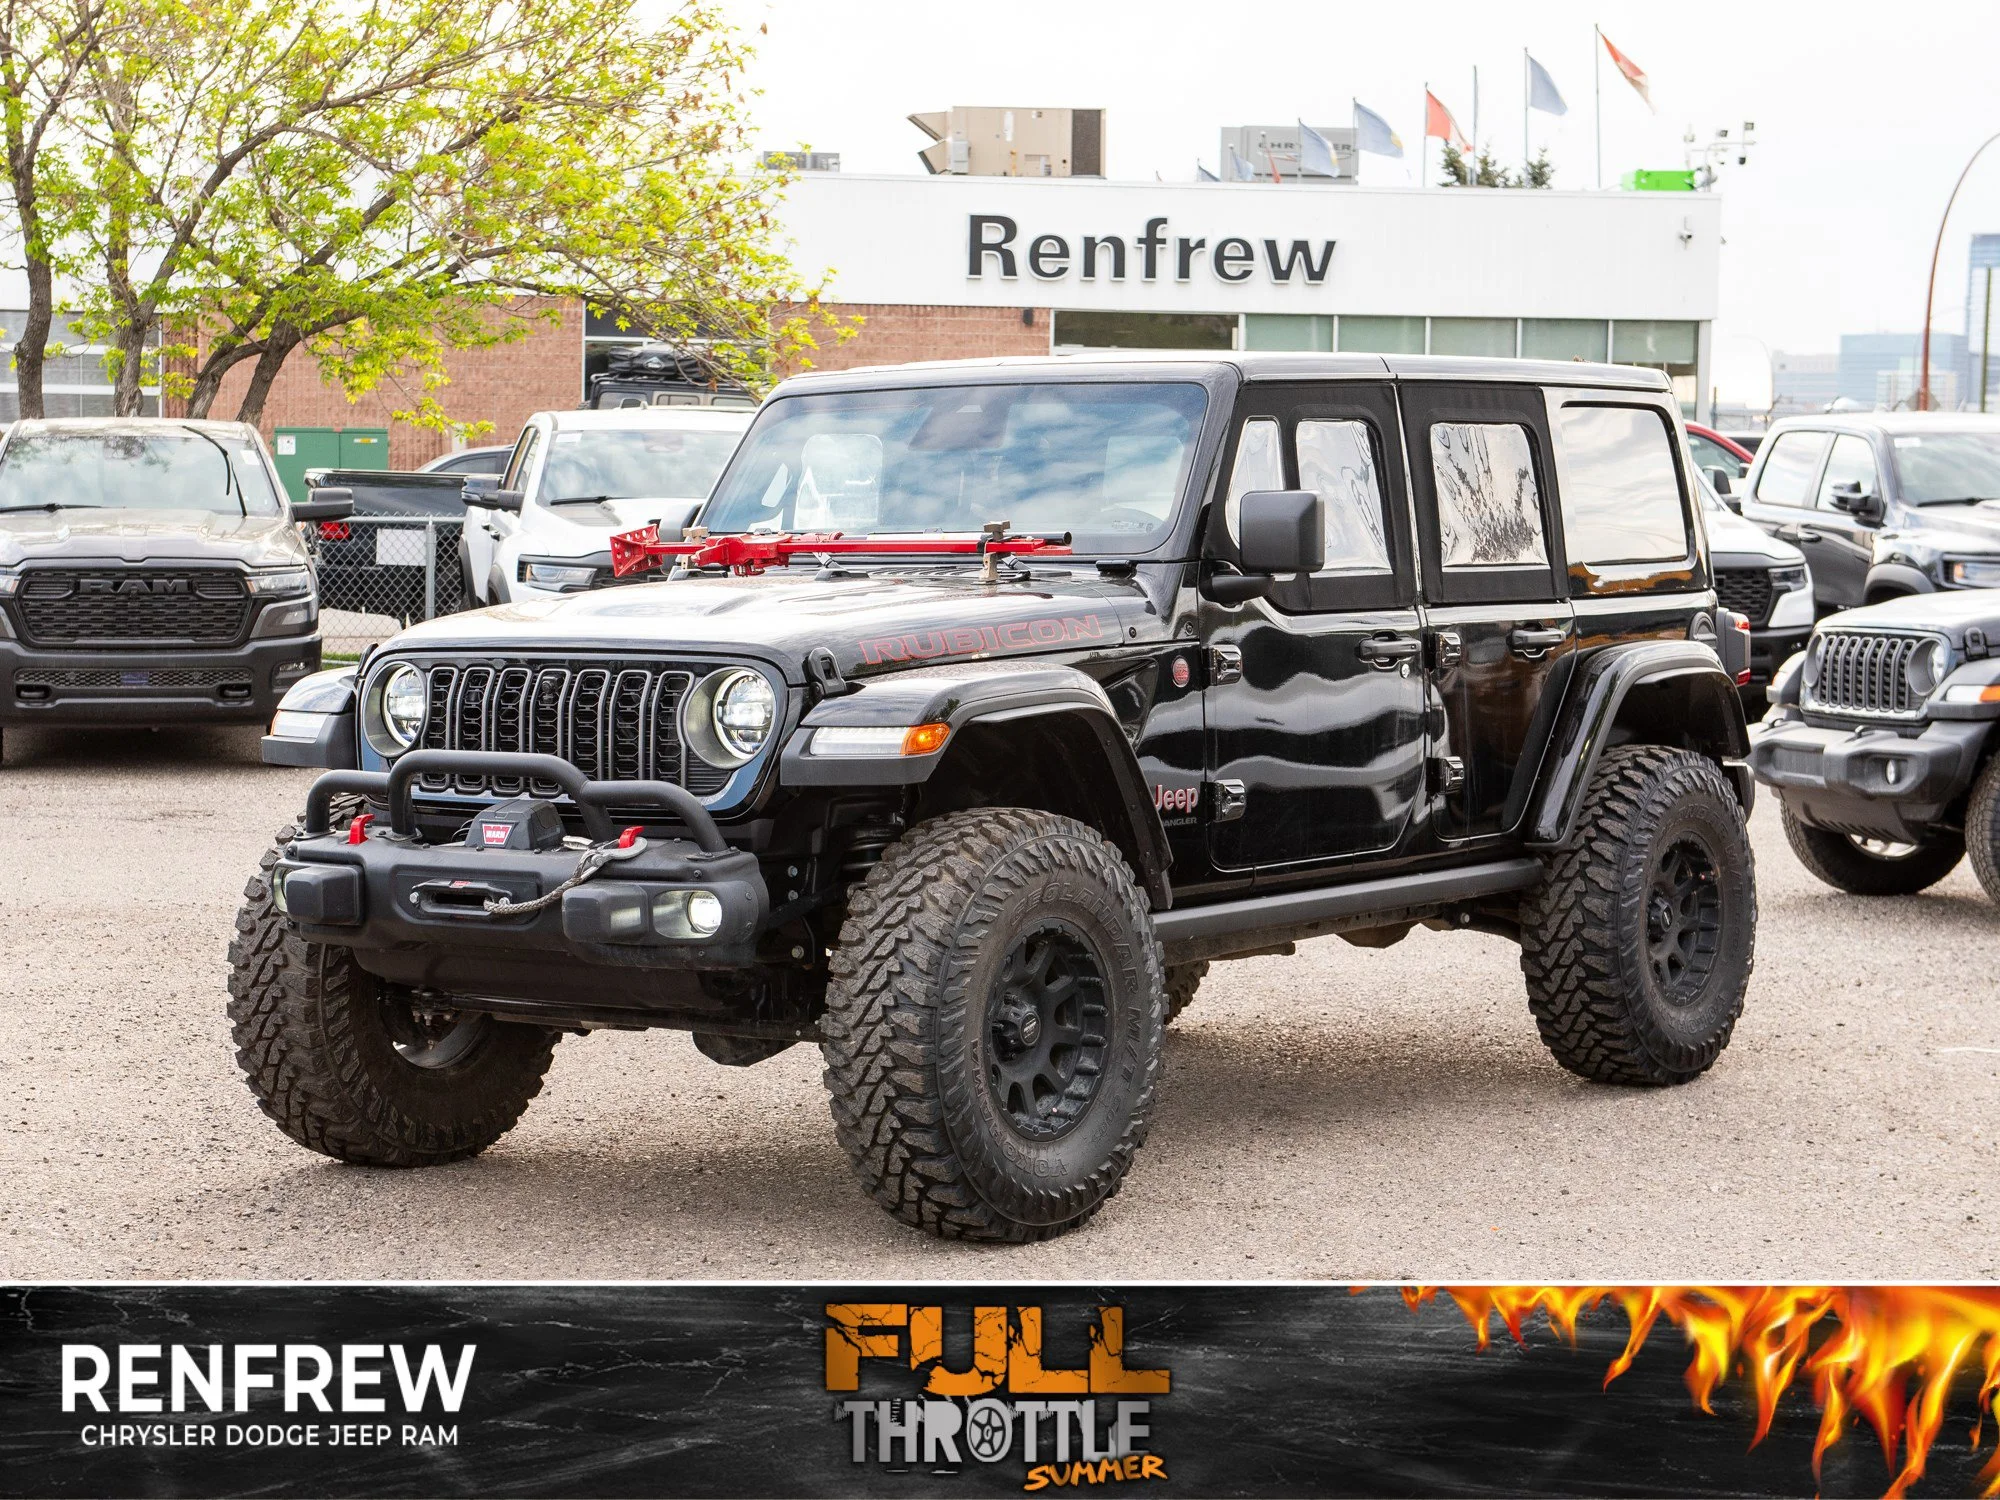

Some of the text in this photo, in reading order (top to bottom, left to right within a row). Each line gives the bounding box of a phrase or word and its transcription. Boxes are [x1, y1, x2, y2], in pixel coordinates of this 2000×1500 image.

[968, 213, 1337, 284] Renfrew
[80, 579, 189, 594] RAM
[859, 614, 1104, 665] RUBICON
[1154, 784, 1199, 814] Jeep
[1162, 816, 1198, 827] ANGLER
